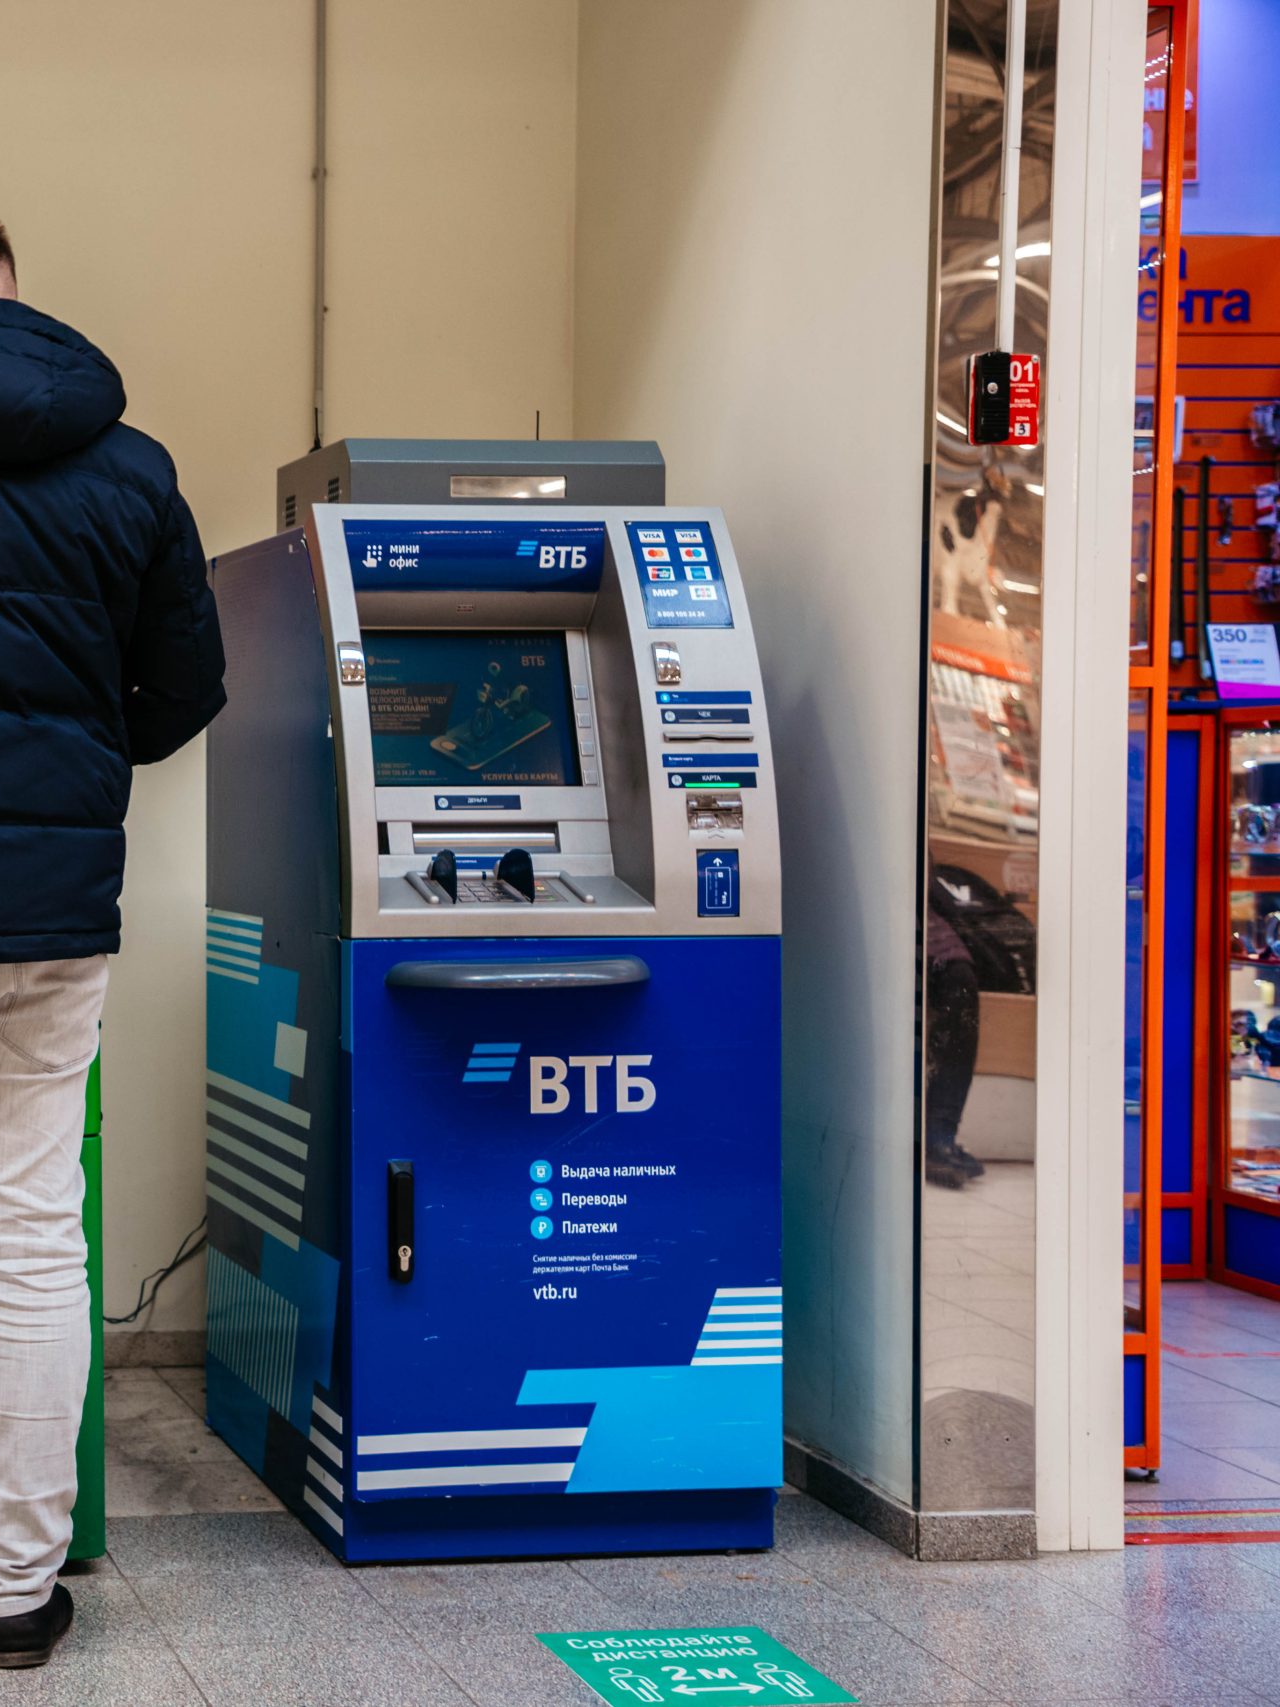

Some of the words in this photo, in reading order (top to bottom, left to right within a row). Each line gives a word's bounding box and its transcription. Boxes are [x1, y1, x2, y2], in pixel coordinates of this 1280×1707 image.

[1010, 361, 1033, 382] 01
[1018, 423, 1026, 435] 3
[389, 544, 420, 554] мини
[389, 557, 419, 570] офис
[539, 545, 588, 569] ВТБ
[1213, 628, 1247, 643] 350
[520, 655, 545, 667] ВТБ
[481, 773, 513, 781] УСЛУГИ
[515, 773, 529, 781] БЕЗ
[530, 1055, 656, 1114] ВТБ
[561, 1164, 610, 1179] Выдача
[613, 1165, 676, 1177] наличных
[562, 1193, 627, 1208] Переводы
[562, 1221, 618, 1234] Платежи
[532, 1254, 557, 1262] Снятие
[591, 1253, 603, 1261] без
[532, 1266, 574, 1274] держателям
[575, 1266, 590, 1274] карт
[591, 1264, 612, 1272] Почта
[533, 1283, 577, 1300] vtb.ru
[566, 1633, 753, 1650] Соблюдайте
[592, 1645, 758, 1662] дистанцию
[660, 1665, 697, 1681] 2
